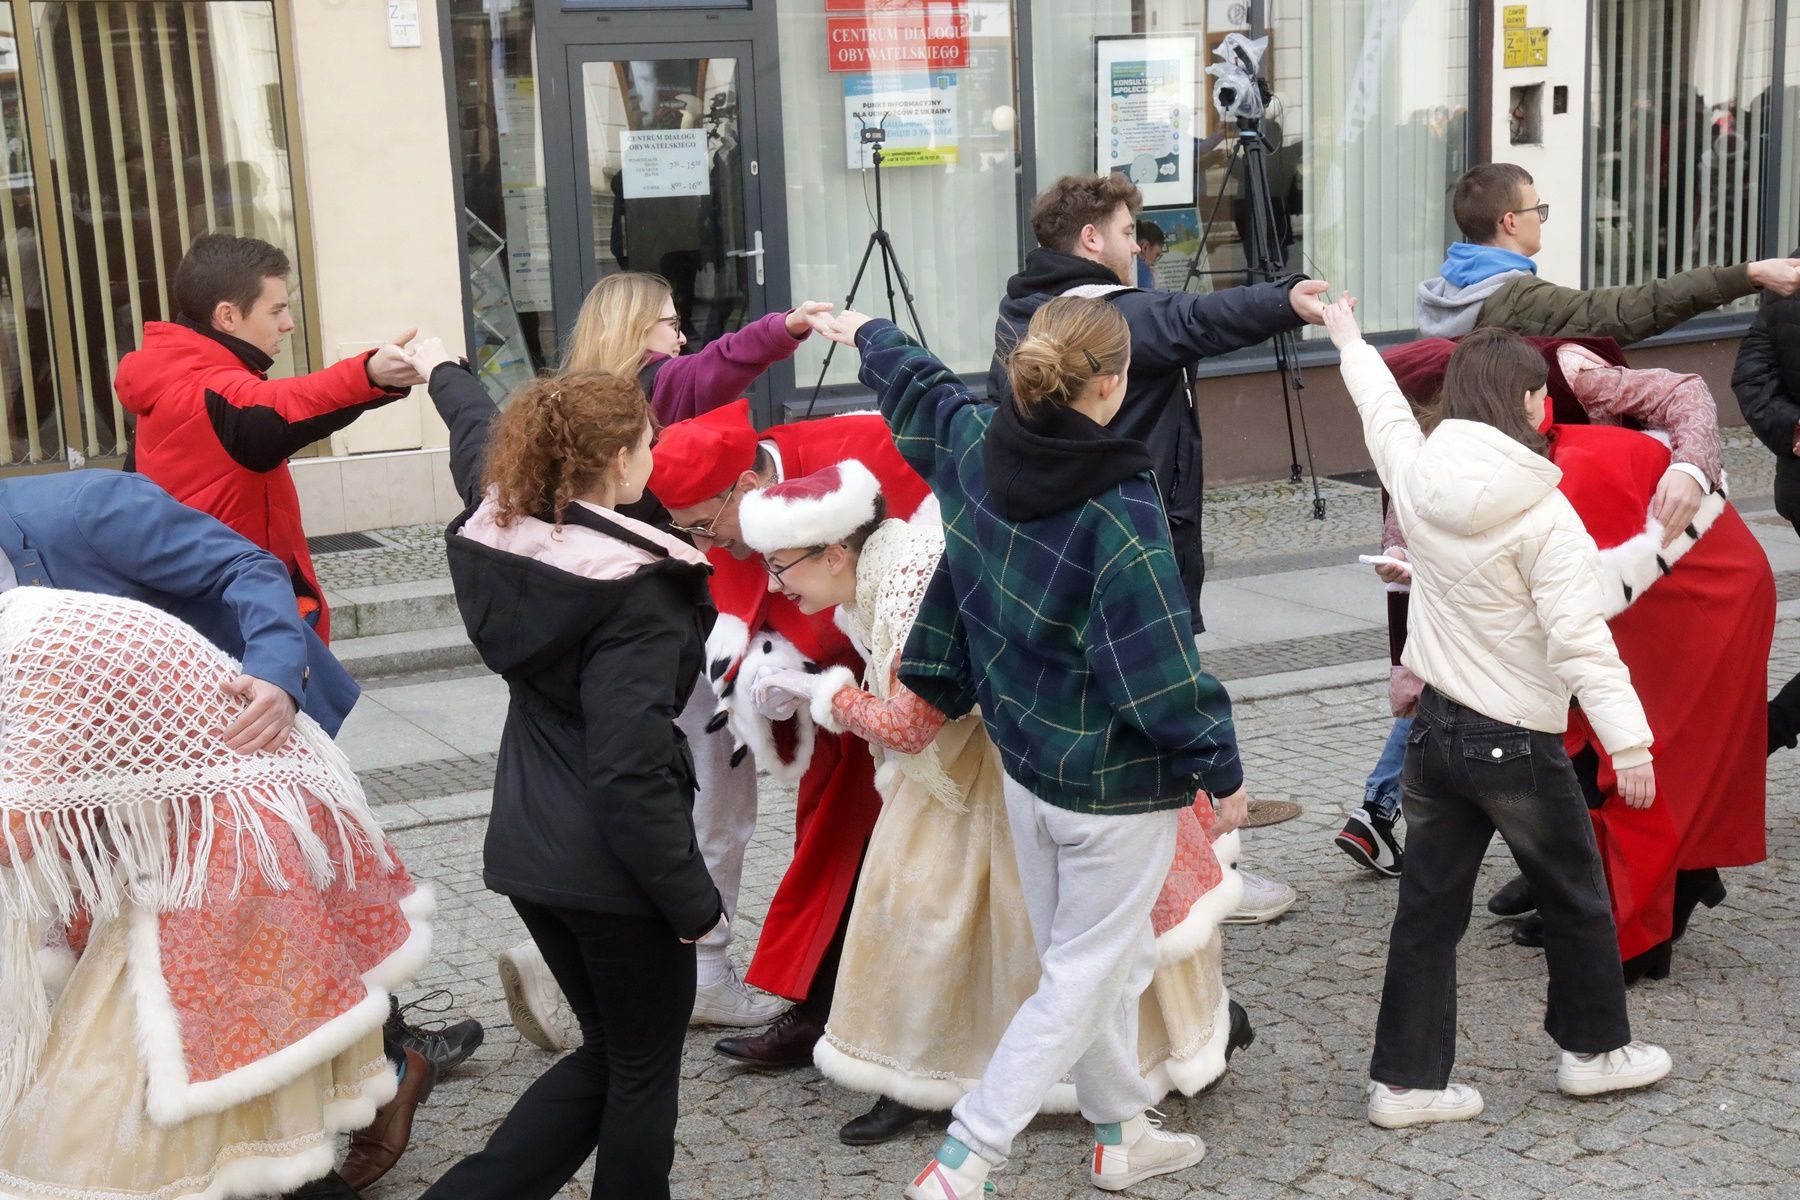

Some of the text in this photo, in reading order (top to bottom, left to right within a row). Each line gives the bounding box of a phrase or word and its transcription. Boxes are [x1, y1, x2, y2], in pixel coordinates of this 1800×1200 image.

[832, 25, 963, 43] CENTRUM DIALOGU
[838, 45, 959, 62] OBYWATELSKIEGO
[664, 133, 696, 141] DIALOGU
[629, 142, 696, 151] OBYWATELSKIEGO
